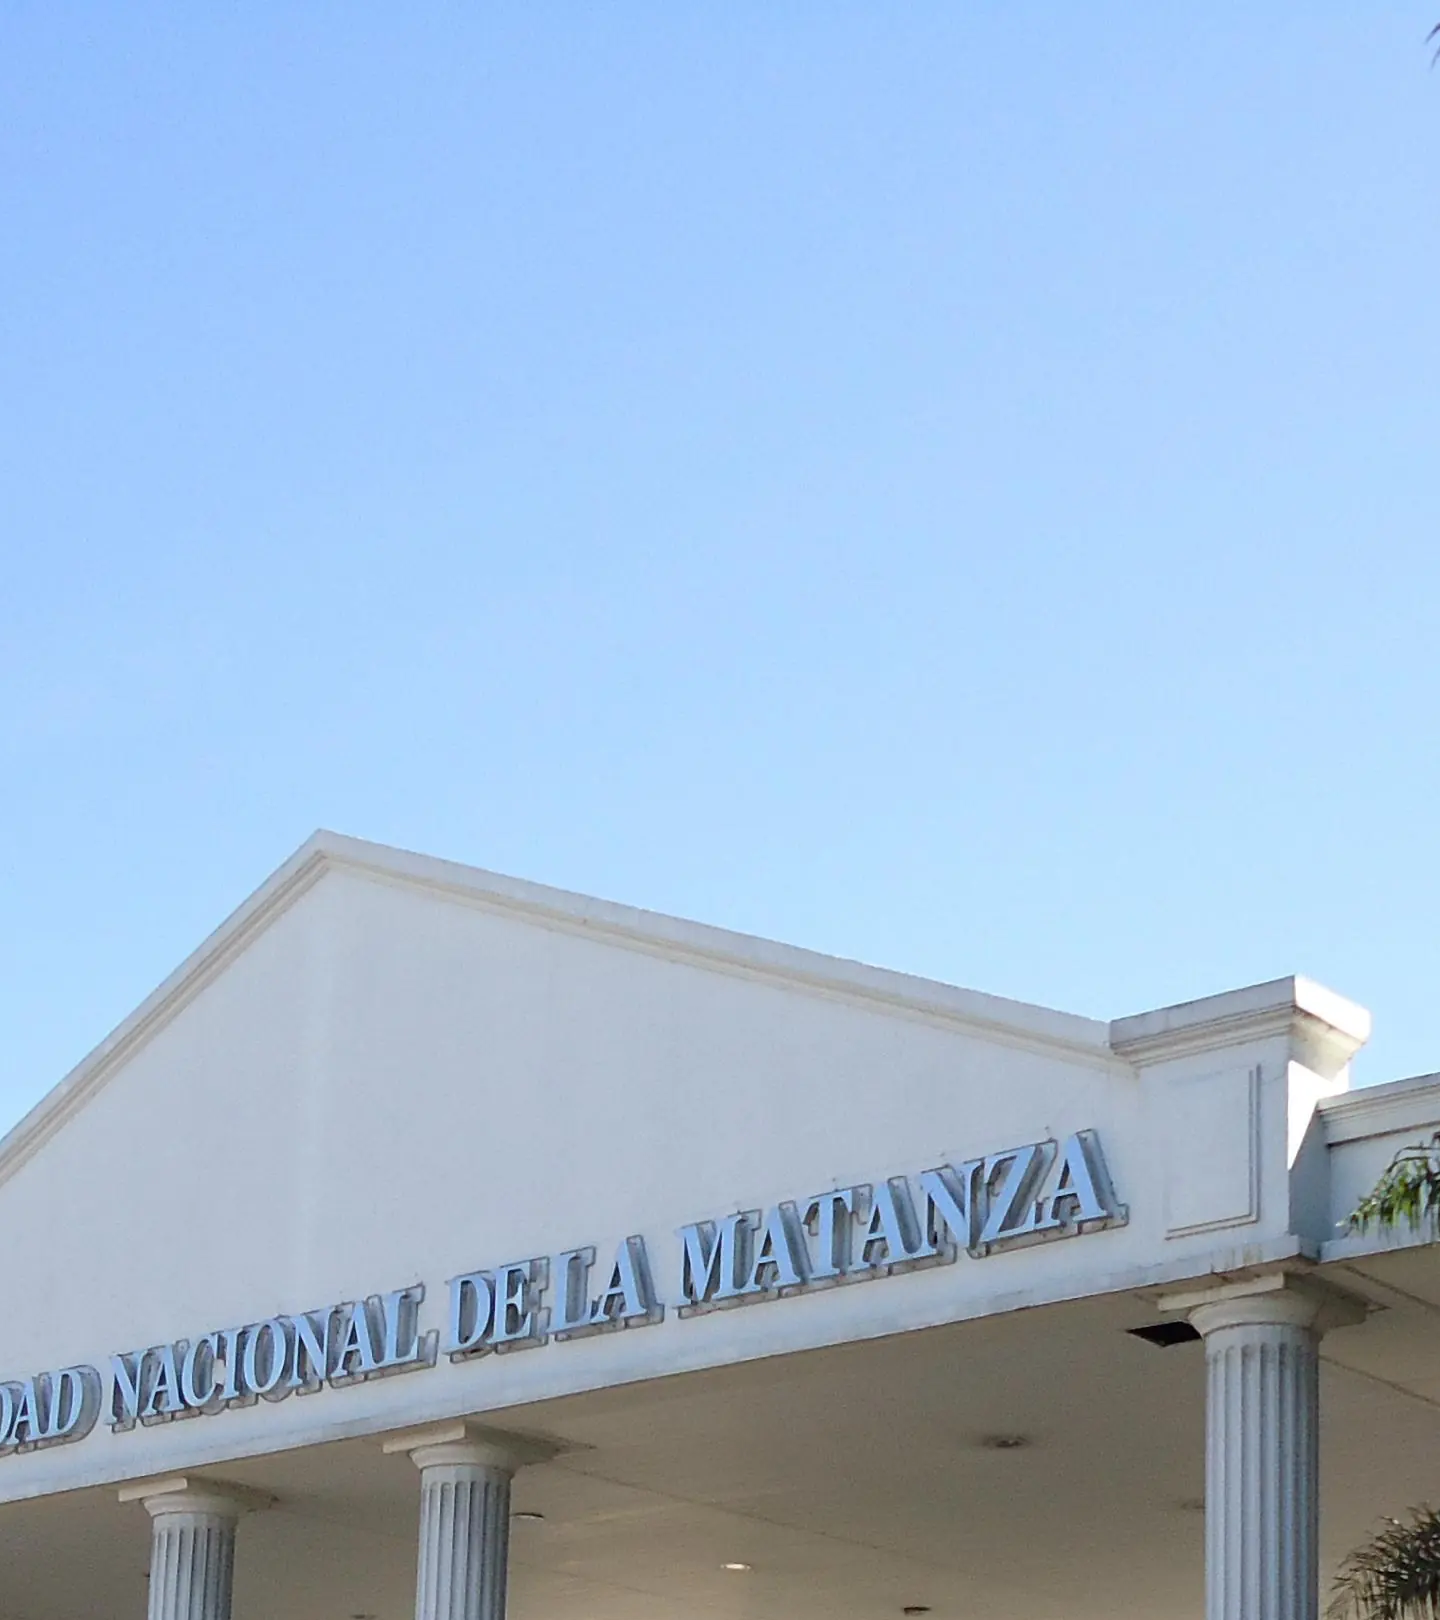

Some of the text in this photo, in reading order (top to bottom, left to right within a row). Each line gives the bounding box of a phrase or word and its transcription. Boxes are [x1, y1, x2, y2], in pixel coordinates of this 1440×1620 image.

[105, 1283, 440, 1434] NACIONAL
[444, 1256, 550, 1364] DE
[543, 1234, 666, 1342] LA
[671, 1129, 1130, 1318] MATANZA
